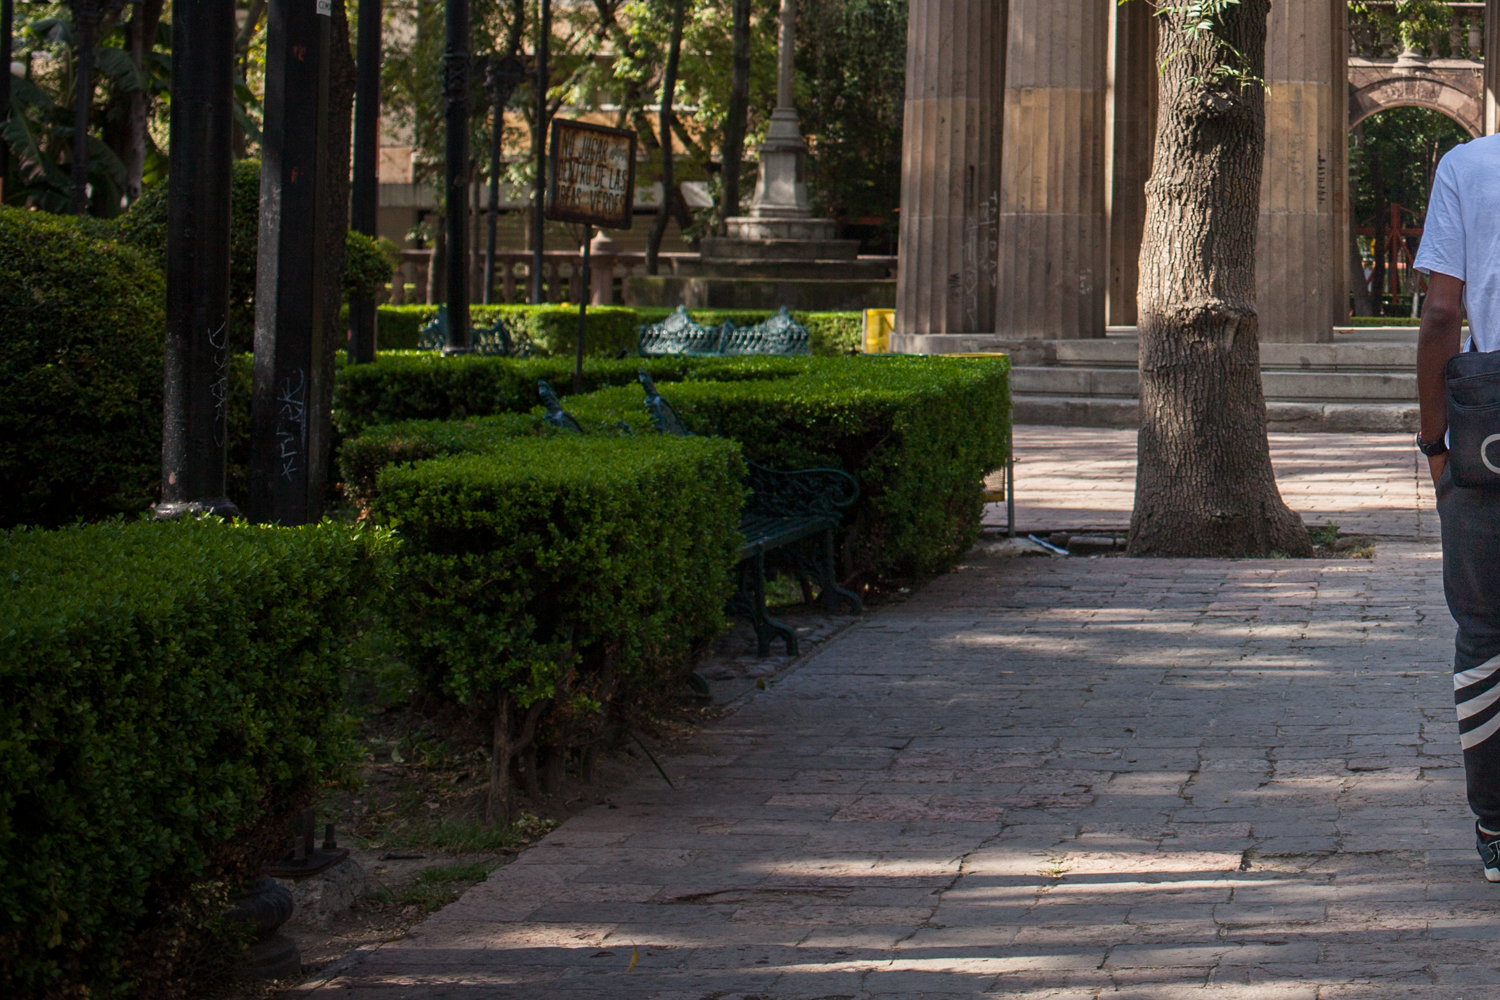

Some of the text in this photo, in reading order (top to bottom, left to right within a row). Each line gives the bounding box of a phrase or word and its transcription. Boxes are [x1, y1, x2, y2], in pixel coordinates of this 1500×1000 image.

[579, 136, 608, 163] JUGAR
[594, 164, 604, 188] DE
[609, 168, 627, 192] LAS
